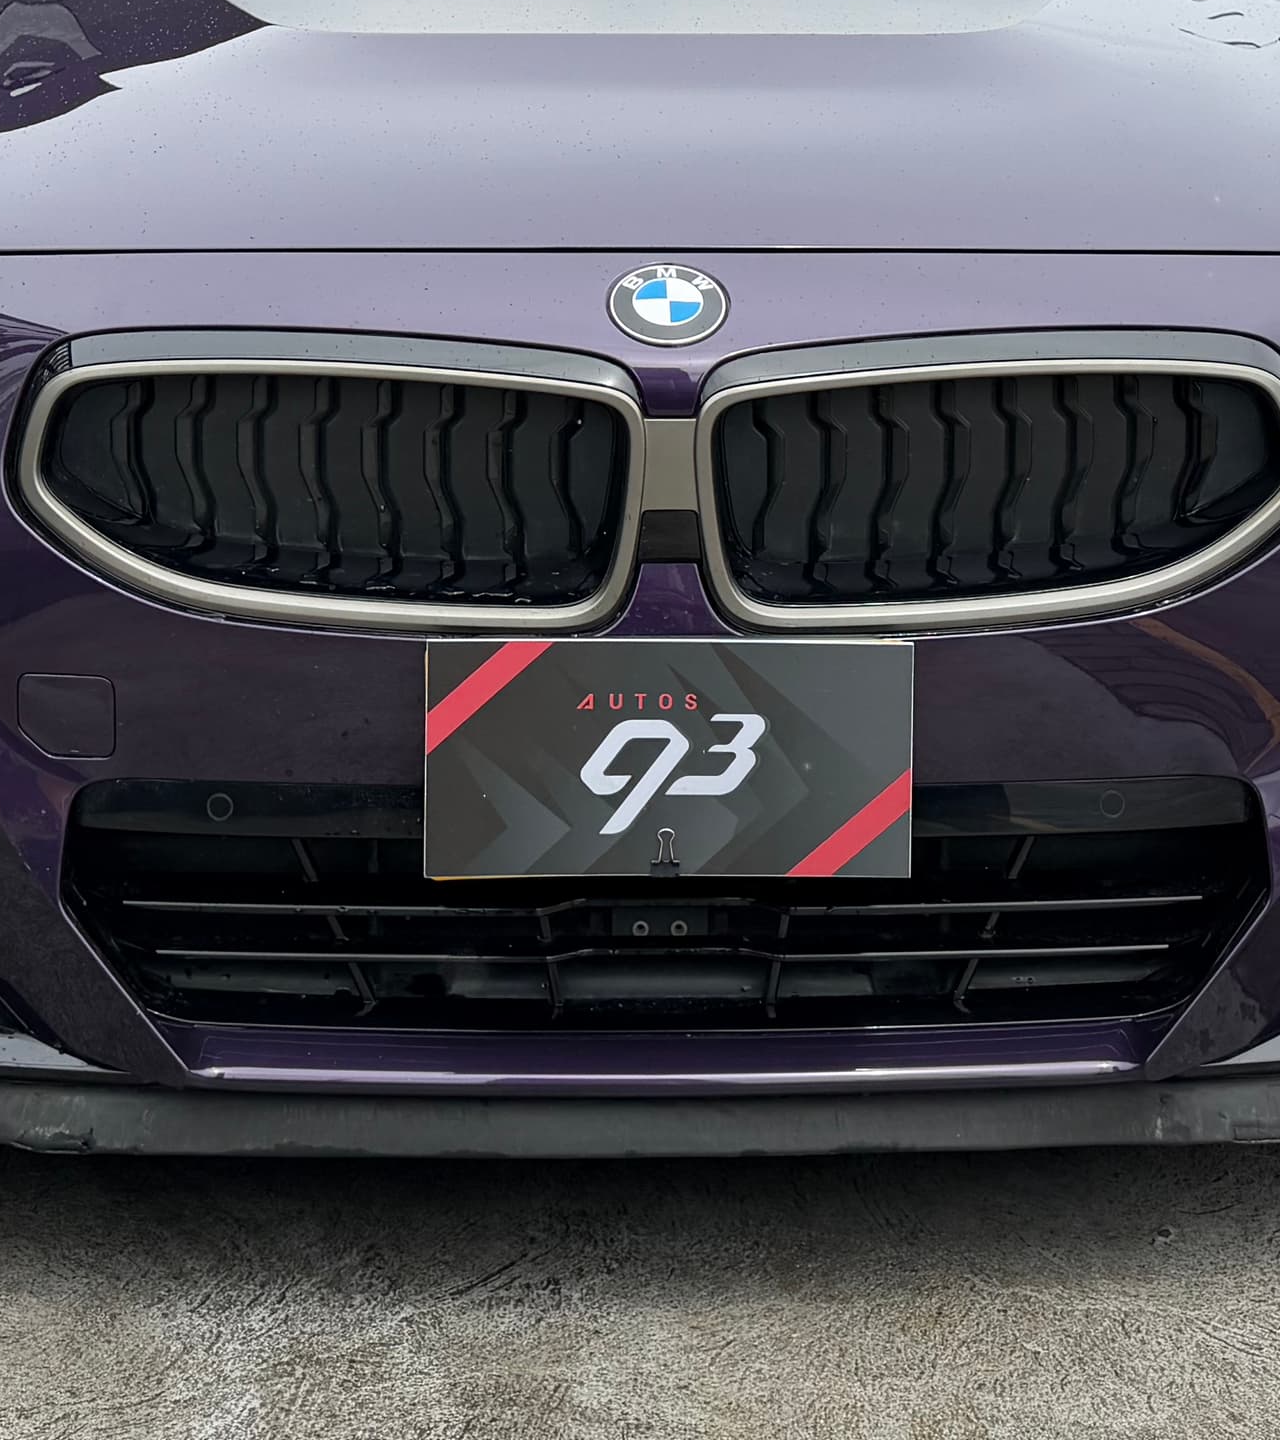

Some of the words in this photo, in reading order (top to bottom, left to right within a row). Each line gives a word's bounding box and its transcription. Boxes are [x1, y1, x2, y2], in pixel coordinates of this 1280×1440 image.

[622, 267, 714, 291] BMW
[577, 693, 698, 711] AUTOS
[580, 713, 766, 835] 93
